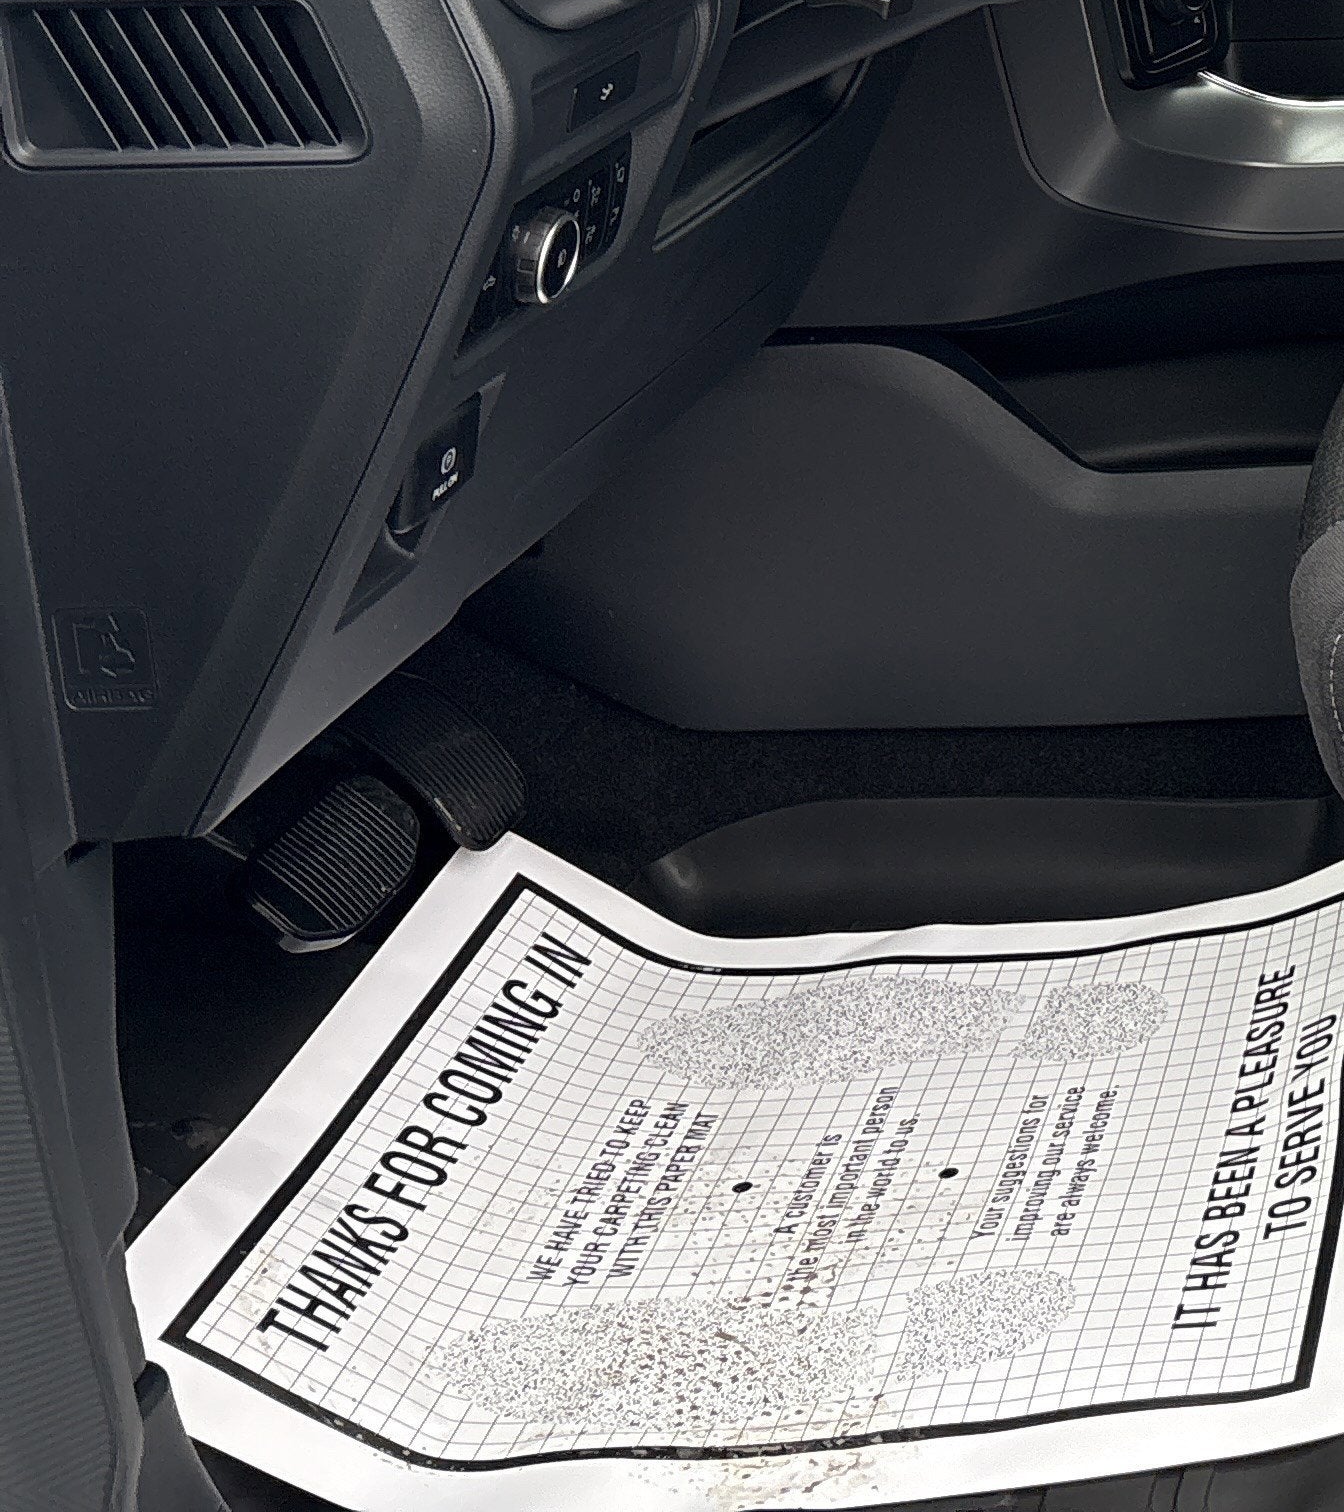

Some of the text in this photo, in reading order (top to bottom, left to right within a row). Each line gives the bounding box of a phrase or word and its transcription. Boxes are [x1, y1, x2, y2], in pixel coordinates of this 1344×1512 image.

[256, 931, 592, 1352] THANKS FOR COMING IN
[526, 1099, 652, 1280] WE HAVE TRIED TO KEEP
[562, 1102, 690, 1287] YOUR CARPETING CLEAN
[607, 1111, 719, 1278] WITH THIS PAPER MAT
[773, 1133, 843, 1235] A customer is
[786, 1086, 900, 1282] the most important person
[867, 1158, 901, 1199] world
[882, 1138, 909, 1155] to
[896, 1112, 921, 1136] us.
[968, 1094, 1049, 1240] Your suggestions for
[1005, 1086, 1086, 1241] improving our service
[1051, 1085, 1120, 1237] are always welcome.
[1171, 964, 1297, 1330] IT HAS BEEN A PLEASURE
[1263, 1013, 1337, 1241] TO SERVE YOU
[847, 1202, 880, 1228] the
